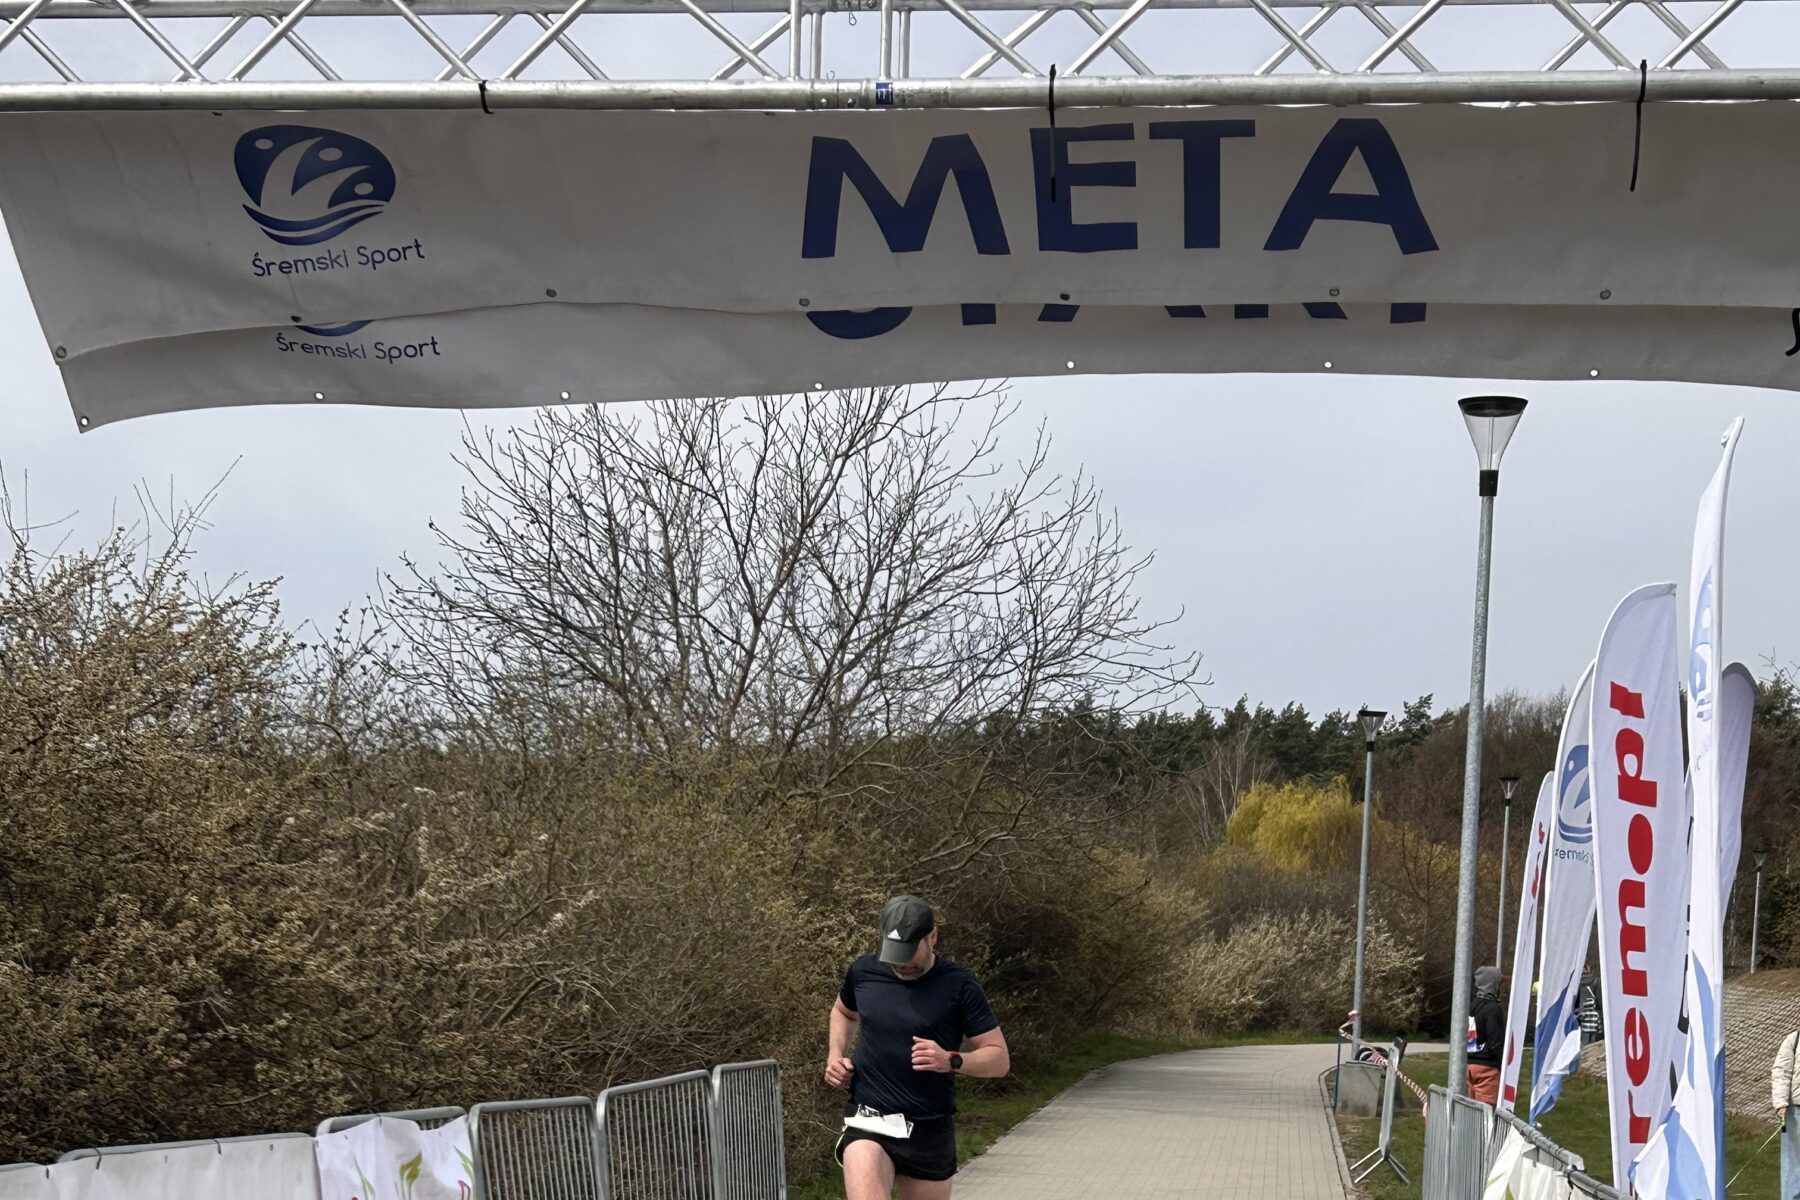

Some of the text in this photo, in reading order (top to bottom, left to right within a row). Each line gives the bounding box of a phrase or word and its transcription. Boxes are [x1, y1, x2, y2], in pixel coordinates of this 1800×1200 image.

[801, 118, 1439, 259] META
[252, 238, 426, 277] Śremski Sport
[276, 332, 441, 365] Śremski Sport
